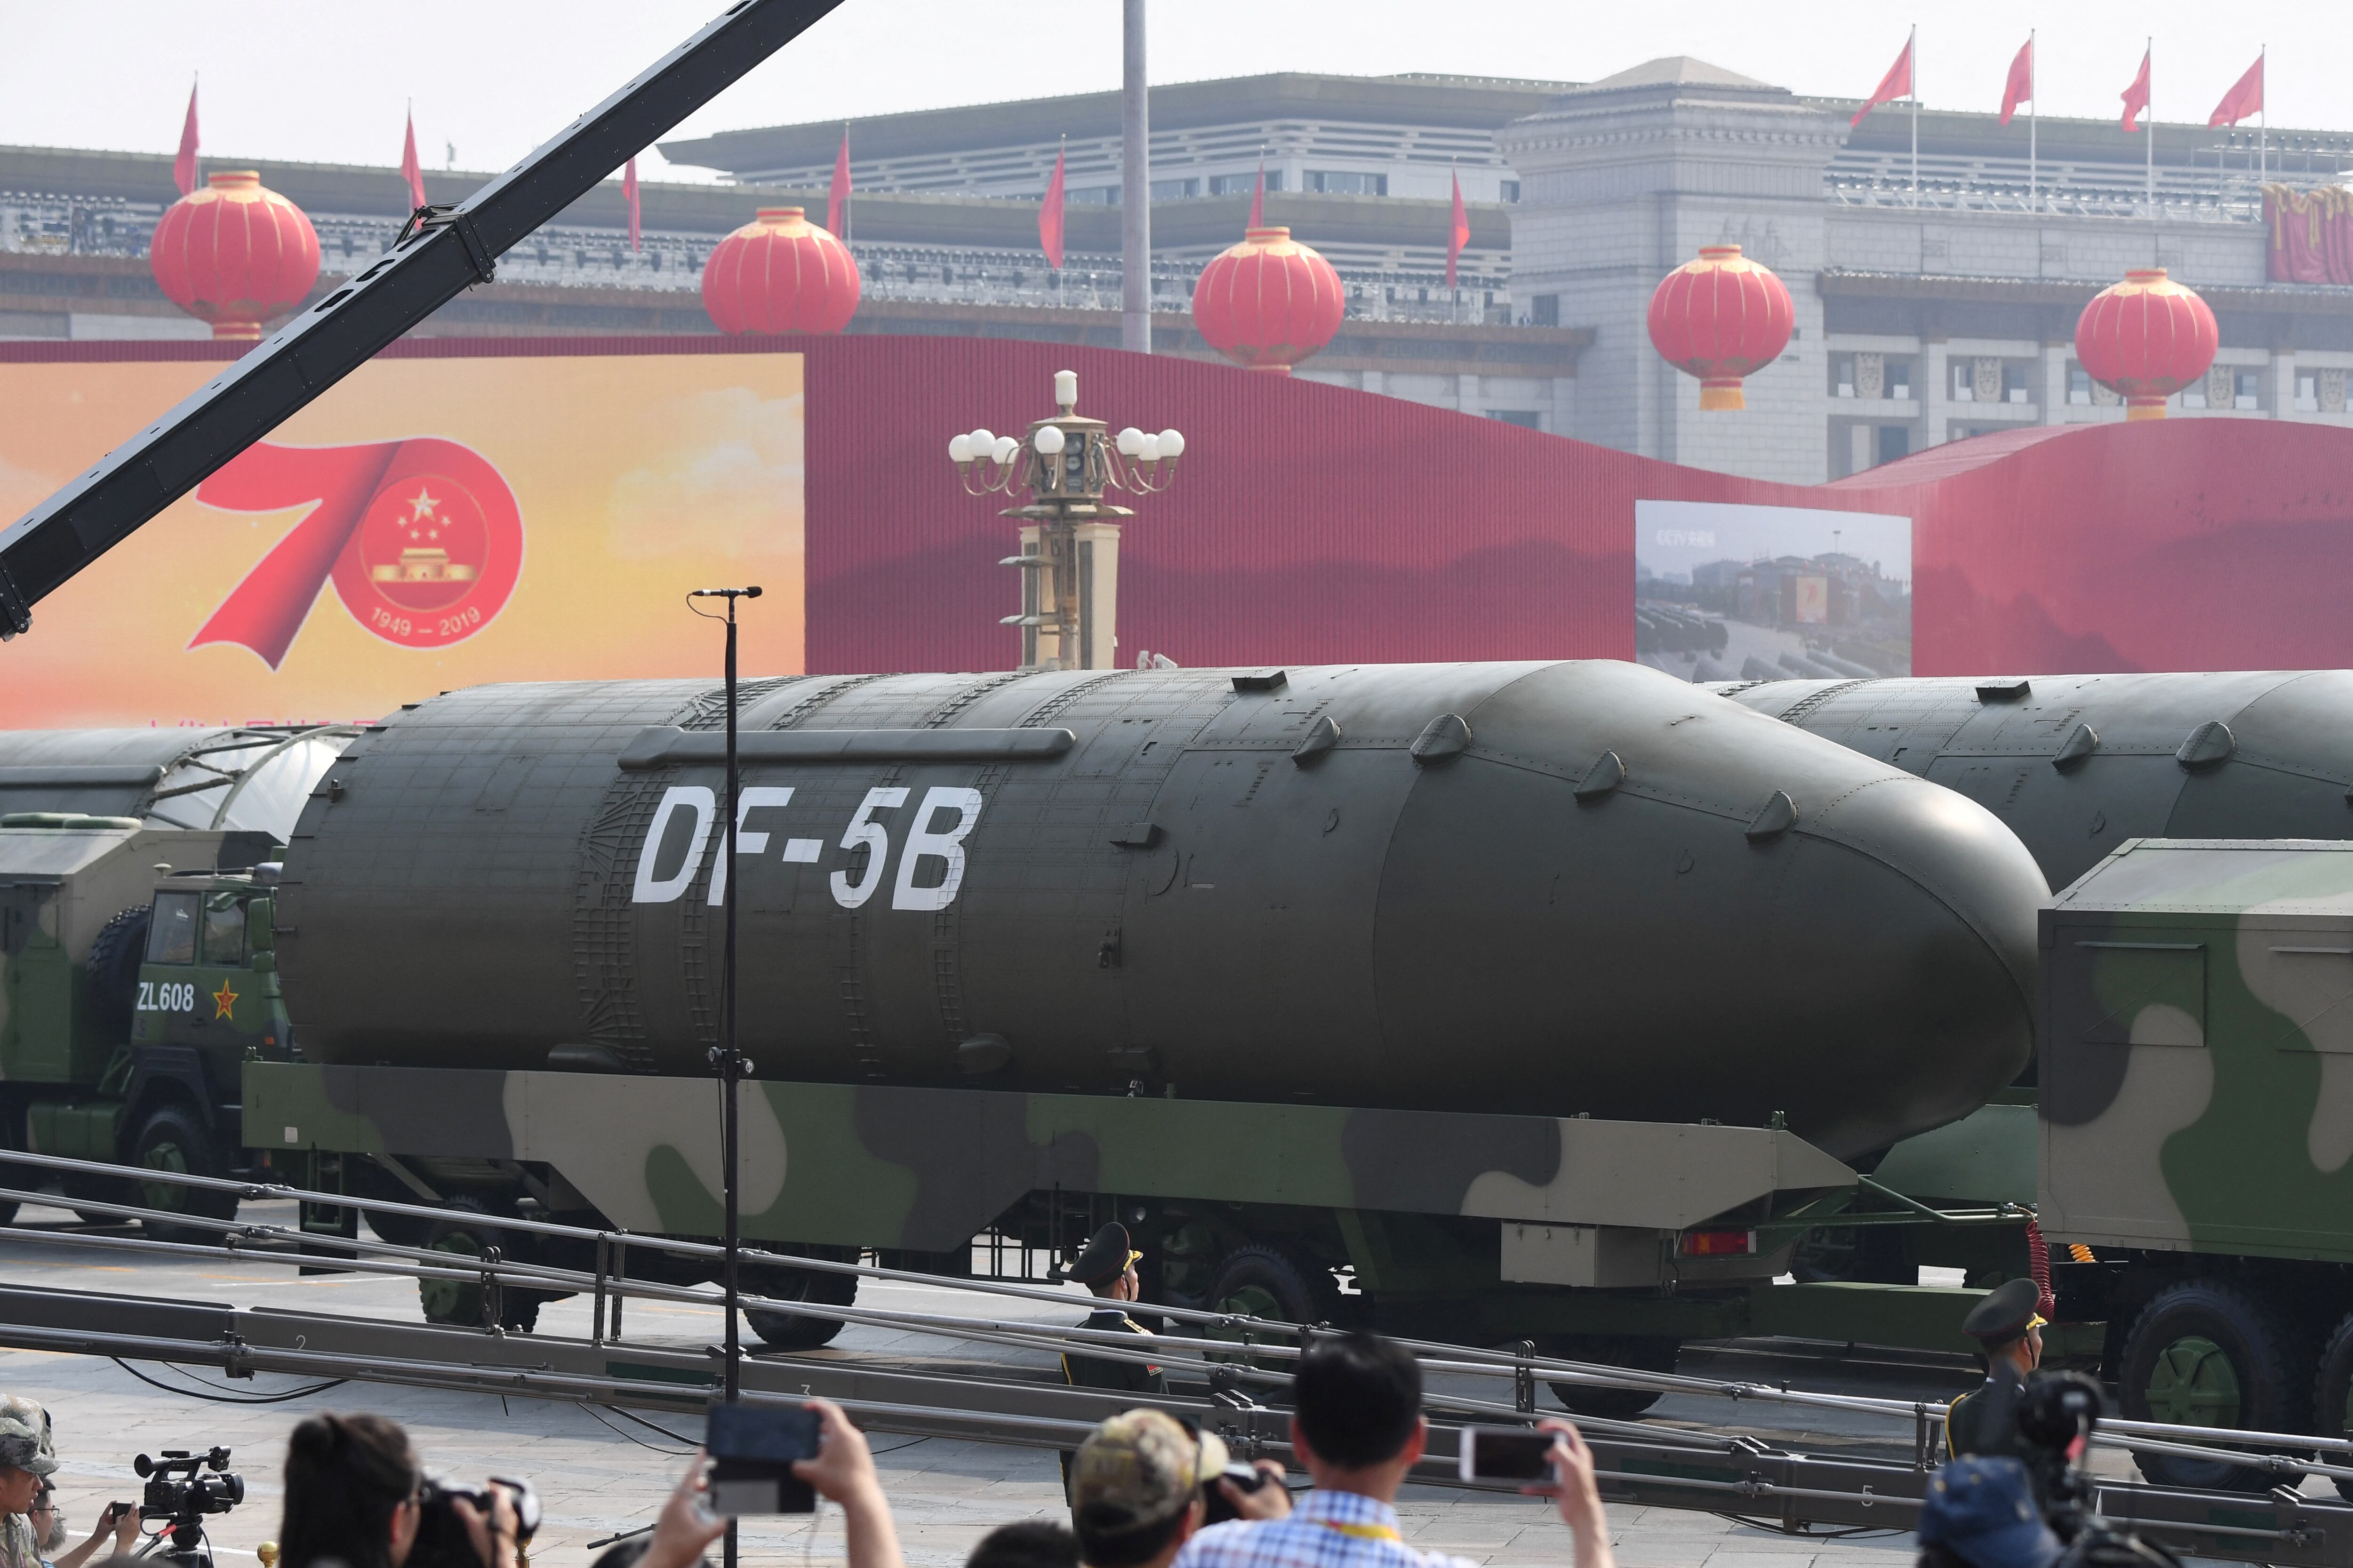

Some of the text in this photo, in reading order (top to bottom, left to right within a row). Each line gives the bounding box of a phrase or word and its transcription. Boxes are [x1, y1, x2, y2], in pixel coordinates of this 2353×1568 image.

[185, 435, 524, 672] 70
[371, 607, 412, 636] 1949
[439, 607, 481, 636] 2019
[632, 786, 983, 911] DF-5B
[137, 982, 194, 1012] ZL608
[1861, 1485, 1873, 1507] 5
